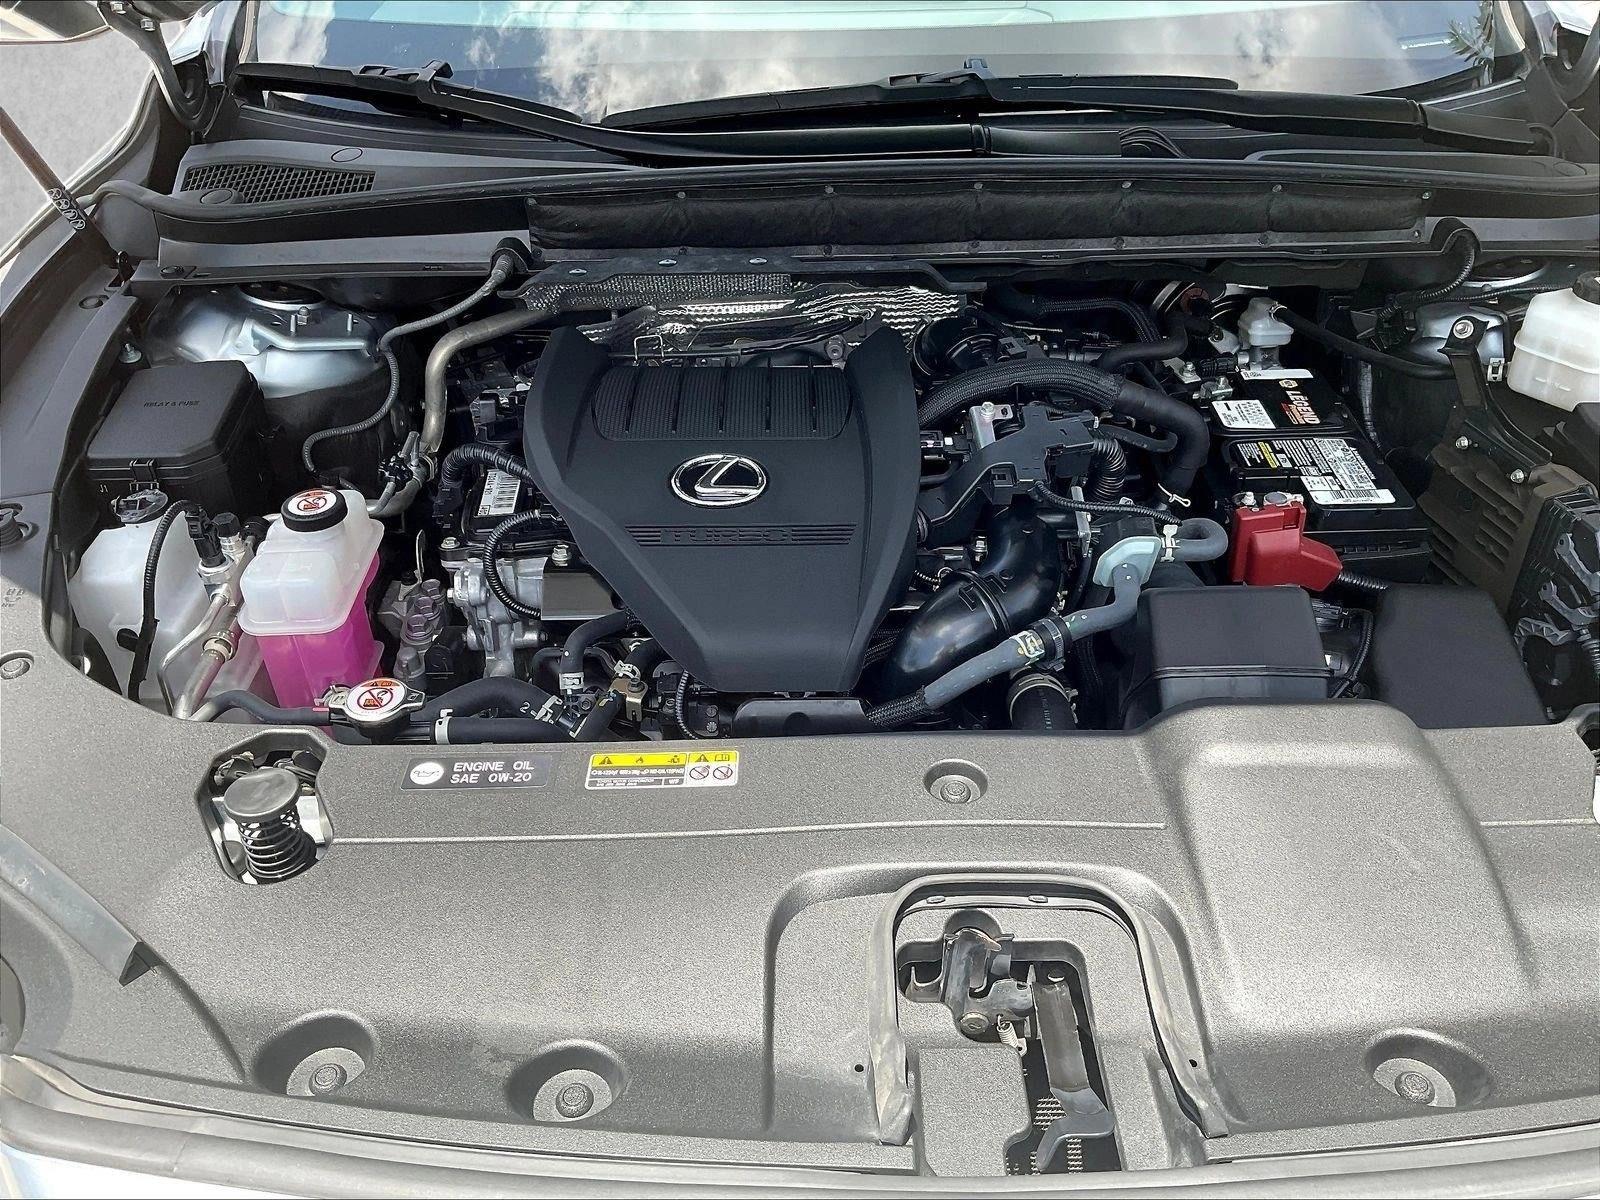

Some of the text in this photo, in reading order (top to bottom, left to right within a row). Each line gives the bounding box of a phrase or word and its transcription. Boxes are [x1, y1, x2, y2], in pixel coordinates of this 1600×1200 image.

[664, 529, 789, 542] TURBO
[453, 760, 535, 772] ENGINE OIL
[450, 772, 532, 784] SAE 0W-20
